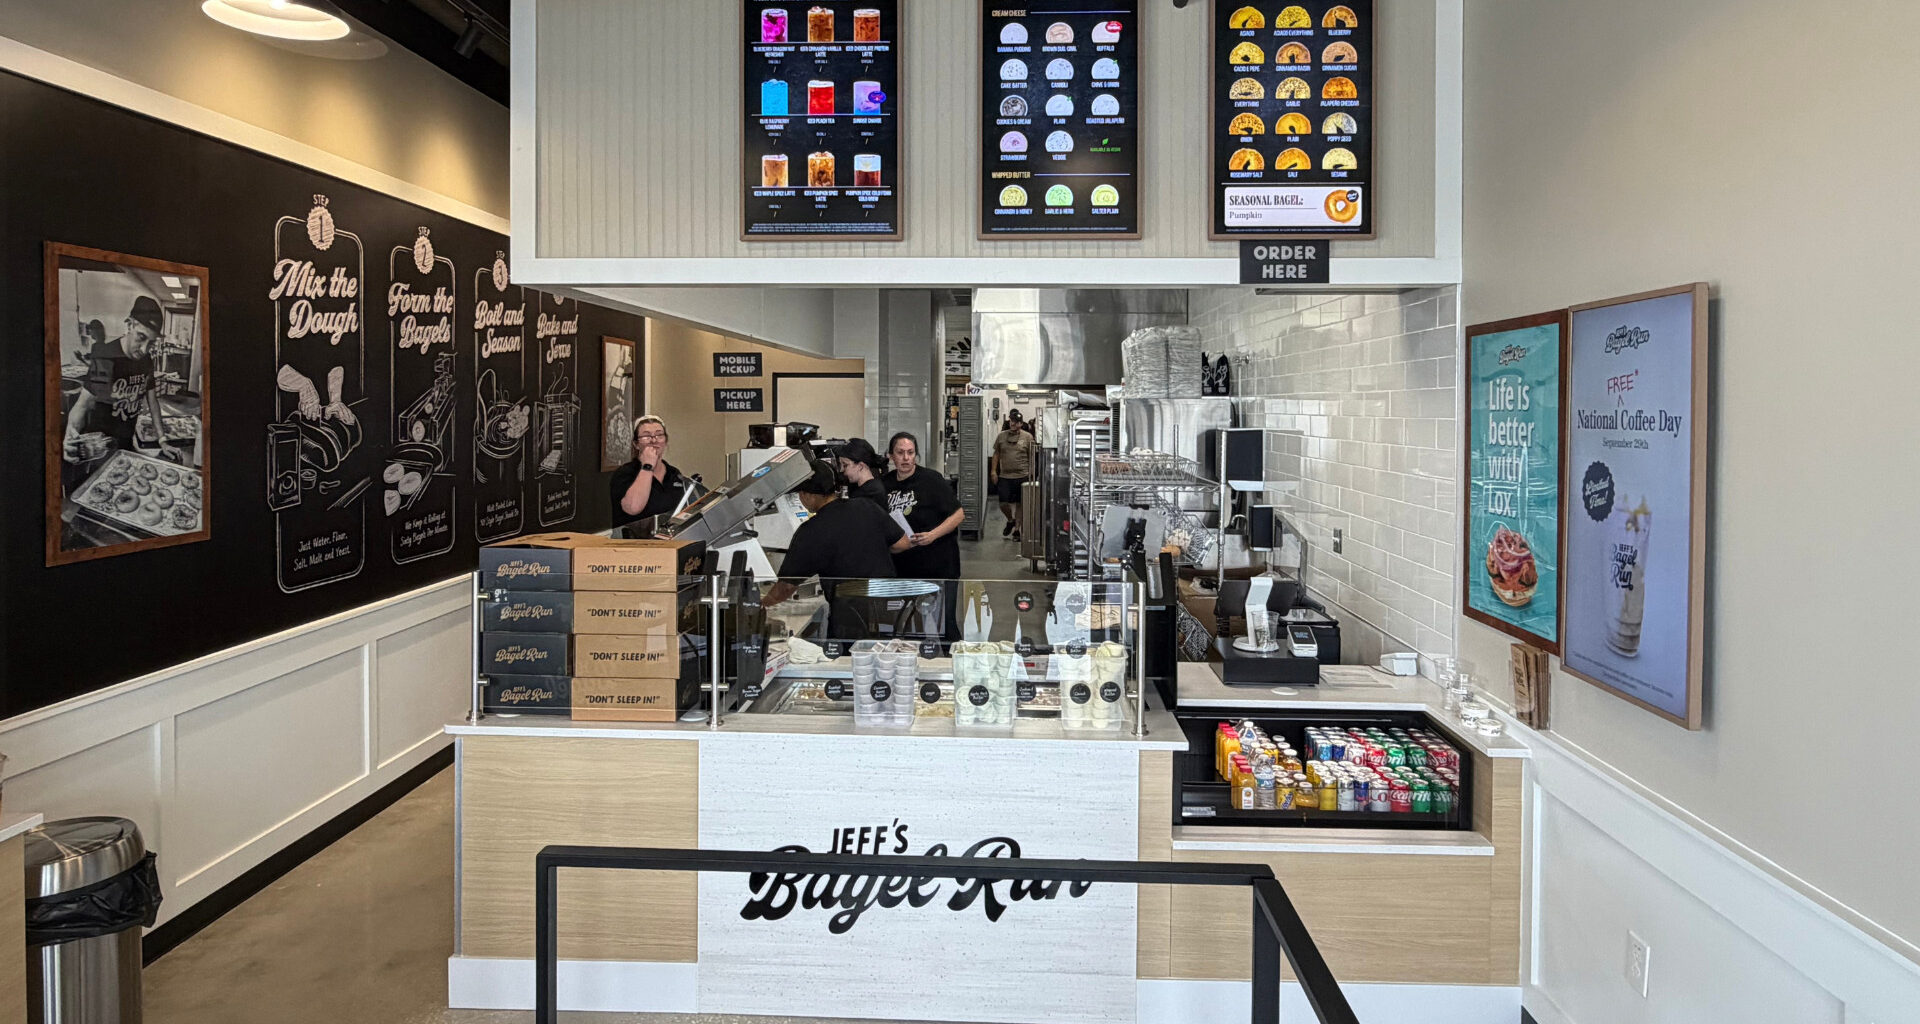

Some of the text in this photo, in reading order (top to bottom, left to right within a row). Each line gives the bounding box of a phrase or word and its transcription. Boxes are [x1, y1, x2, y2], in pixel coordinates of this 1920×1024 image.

[312, 194, 329, 206] STEP
[1229, 195, 1304, 206] SEASONAL BAGEL:
[1229, 211, 1262, 220] Pumpkin
[417, 226, 430, 237] STEP
[1253, 245, 1316, 261] ORDER
[269, 258, 358, 301] Mix the
[1262, 264, 1307, 279] HERE
[388, 282, 454, 317] Form the
[287, 299, 358, 346] Dough
[474, 300, 526, 330] Boil and
[536, 312, 579, 340] Bake and
[399, 315, 451, 355] Bagels
[482, 328, 522, 359] Season
[1604, 326, 1650, 355] Bagel Run
[546, 337, 572, 362] Serve
[719, 356, 756, 364] MOBILE
[720, 366, 756, 374] PICKUP
[720, 391, 757, 400] PICKUP
[1489, 376, 1530, 411] Life is
[726, 402, 752, 410] HERE
[1488, 414, 1534, 447] better
[1577, 409, 1682, 438] National Coffee Day
[1602, 437, 1648, 450] September 29th
[1488, 450, 1521, 481] with
[1584, 476, 1610, 496] Limited
[1488, 483, 1516, 518] Lox.
[412, 518, 422, 530] Keep
[298, 540, 311, 552] Just
[309, 553, 322, 565] Malt
[324, 548, 334, 560] and
[1610, 544, 1638, 570] Bagel
[496, 562, 551, 579] Bagel Run
[618, 565, 643, 574] SLEEP
[1610, 563, 1634, 591] Run
[500, 605, 554, 622] Bagel Run
[618, 609, 643, 618] SLEEP
[494, 647, 548, 663] Bagel Run
[621, 652, 646, 661] SLEEP
[500, 688, 553, 705] Bagel Run
[617, 696, 641, 704] SLEEP
[827, 818, 908, 855] JEFF'S
[739, 843, 948, 934] Bagel
